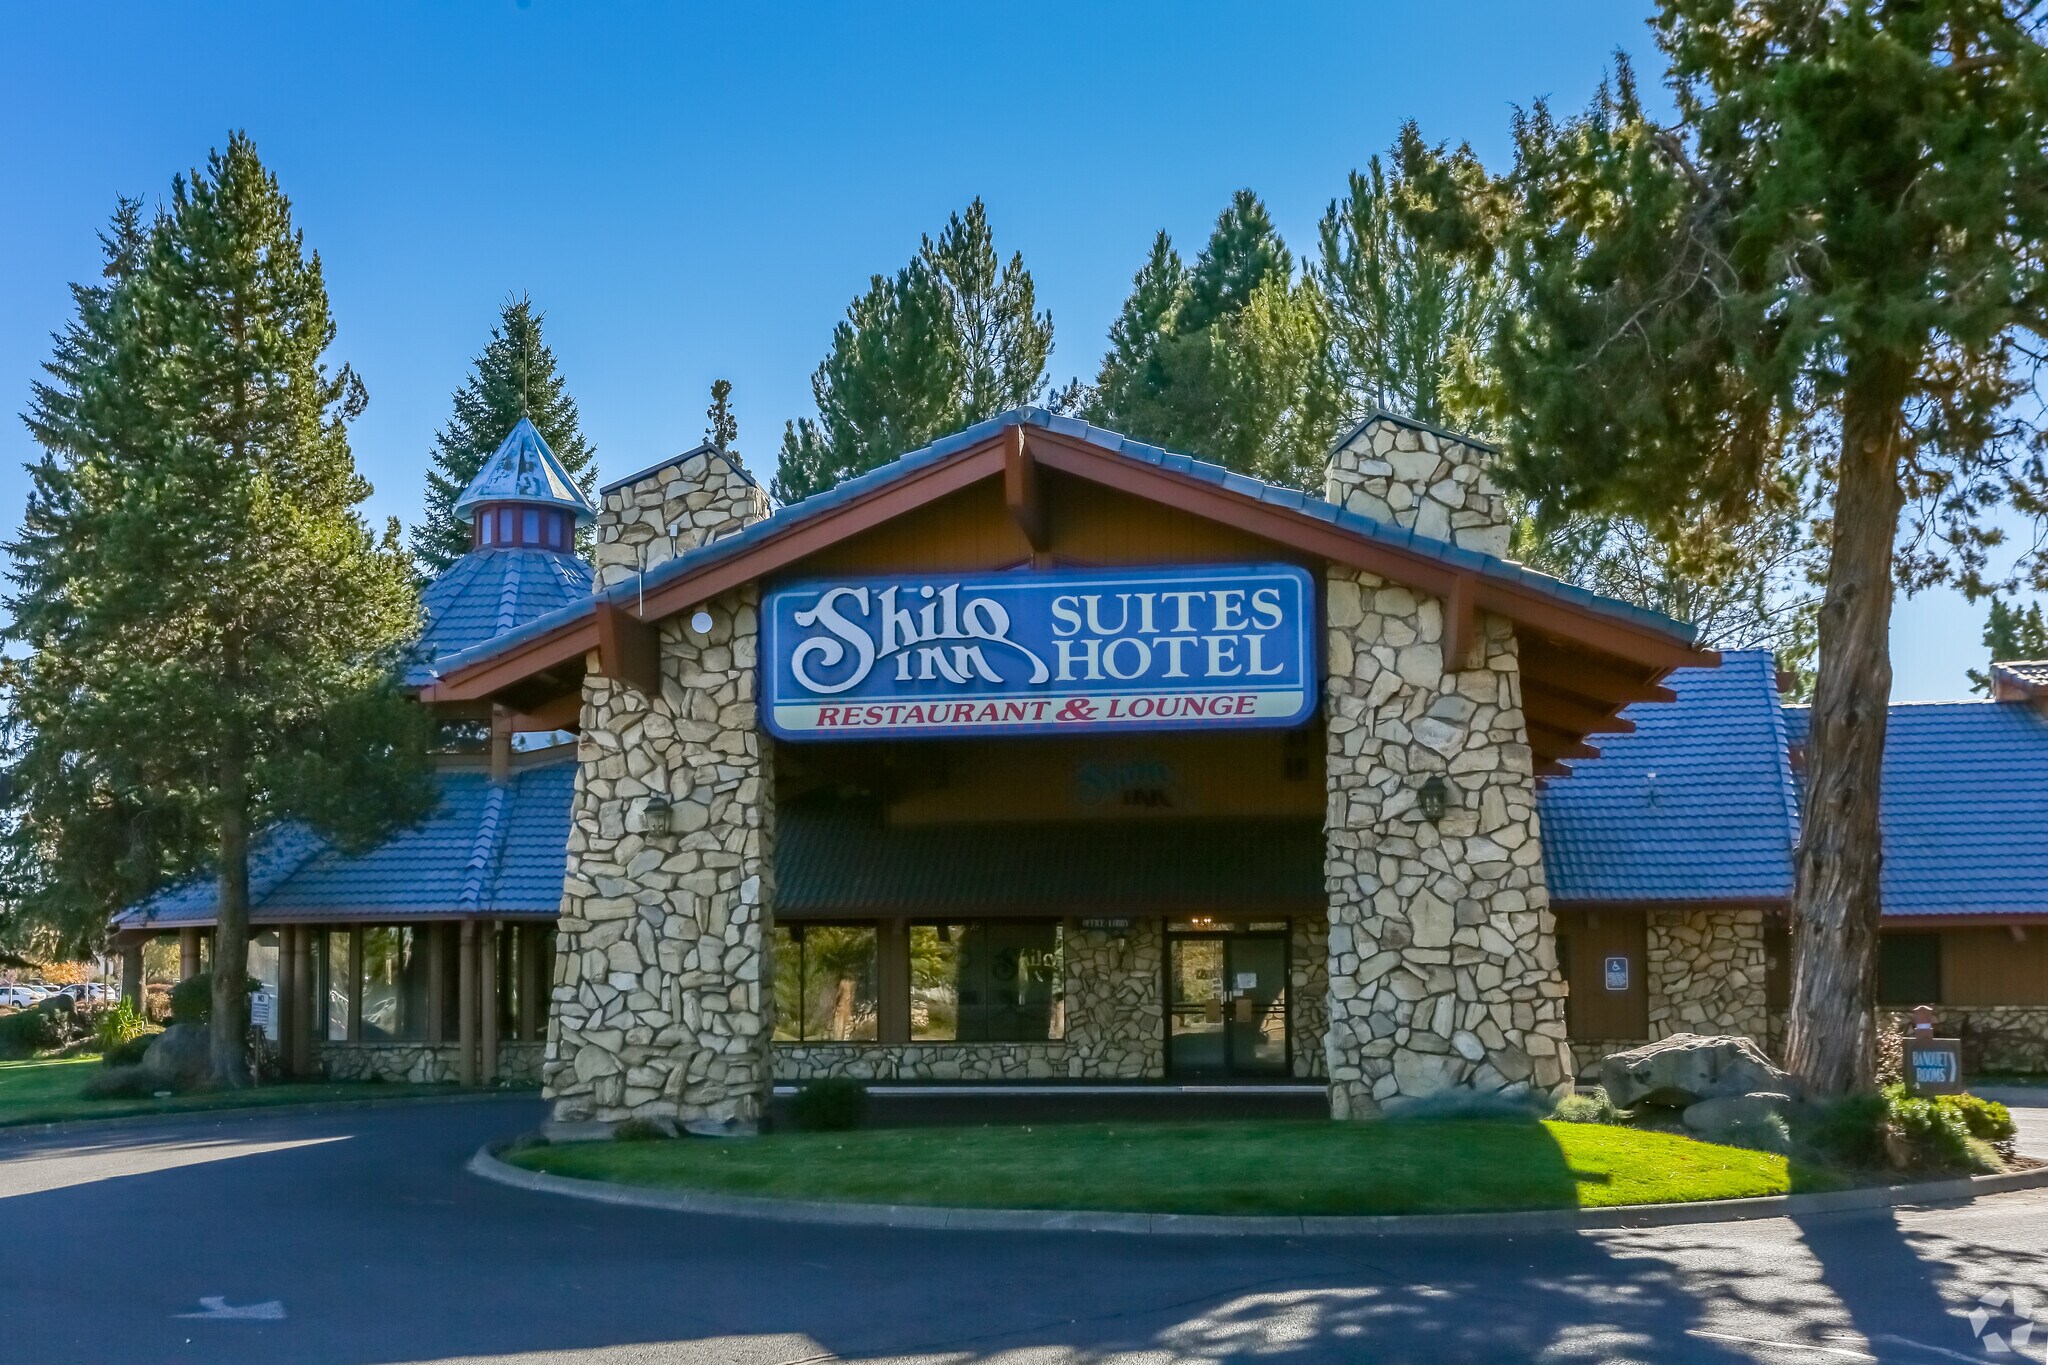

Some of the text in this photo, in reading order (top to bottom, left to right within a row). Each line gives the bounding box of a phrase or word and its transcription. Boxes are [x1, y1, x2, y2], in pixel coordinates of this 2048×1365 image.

[1051, 588, 1283, 637] SUITES
[791, 582, 1050, 694] Shilo
[1052, 633, 1284, 682] HOTEL
[815, 695, 1258, 727] RESTAURANT & LOUNGE
[1912, 1051, 1948, 1067] BANQUET
[1916, 1067, 1946, 1083] ROOMS
